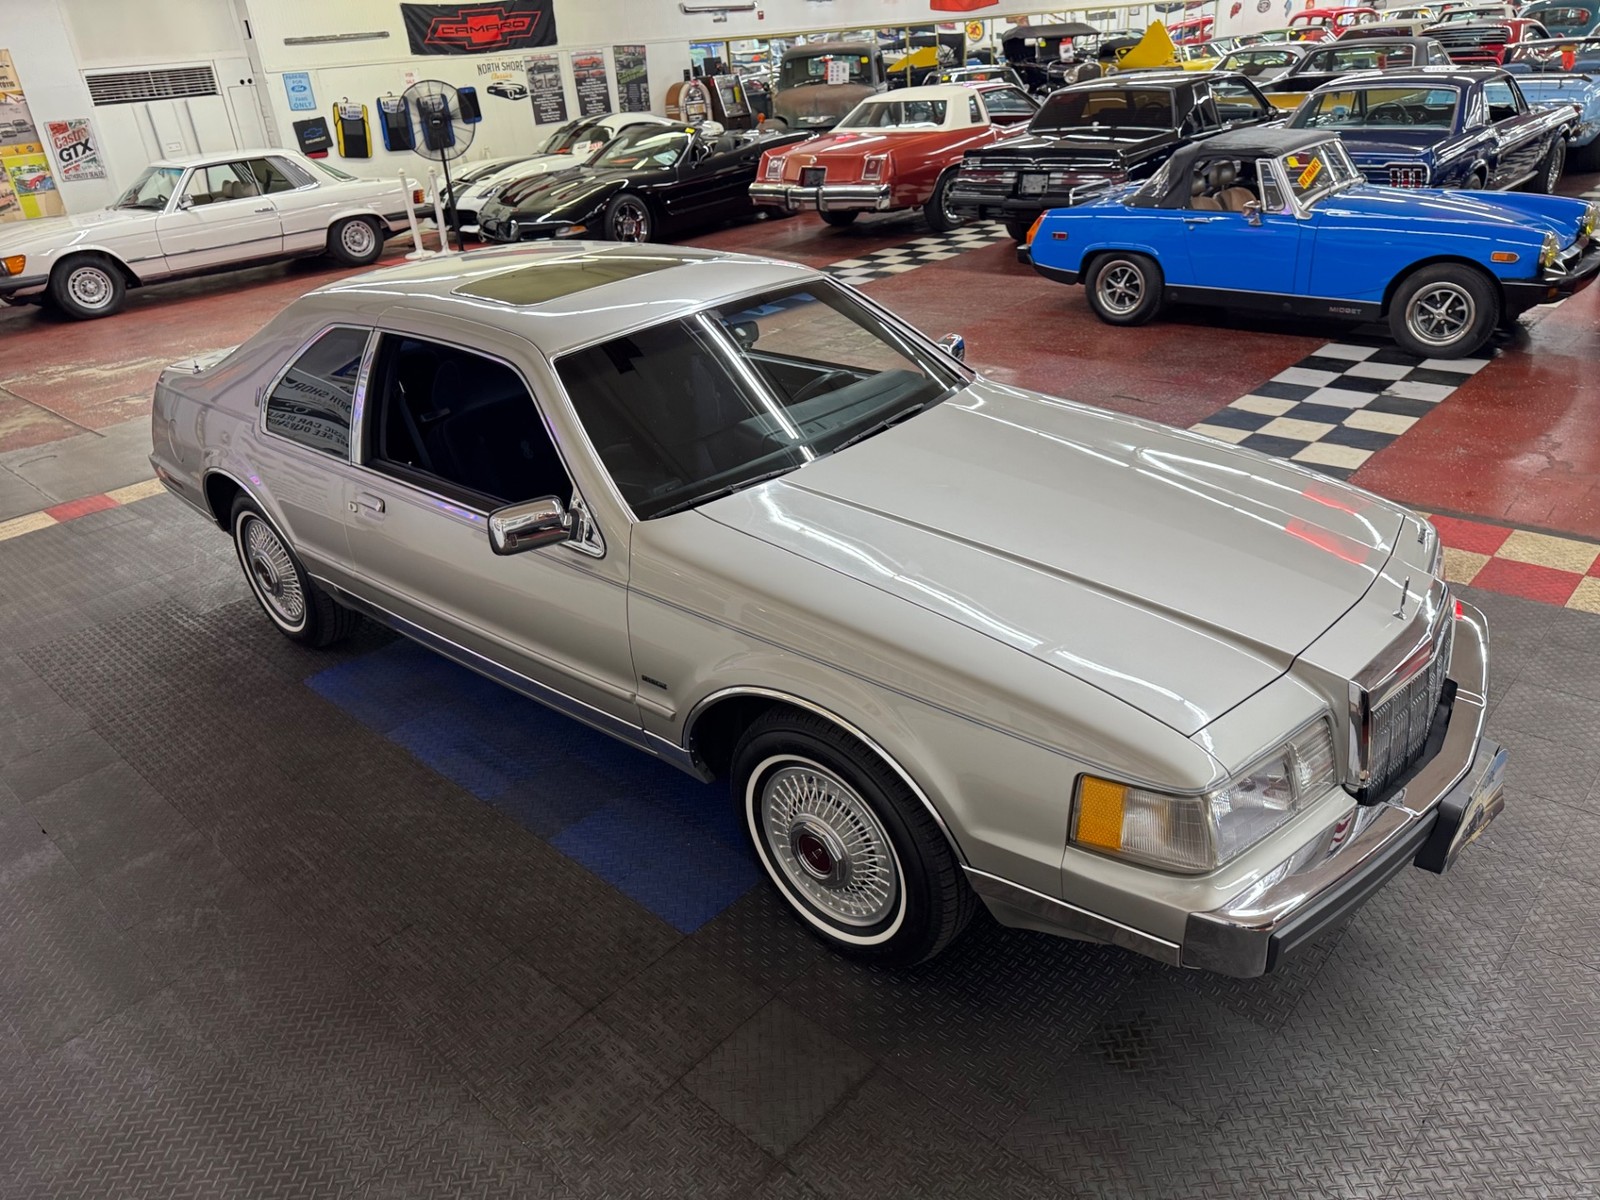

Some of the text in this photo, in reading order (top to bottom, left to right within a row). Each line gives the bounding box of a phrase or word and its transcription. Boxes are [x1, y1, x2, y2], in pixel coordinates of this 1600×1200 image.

[441, 20, 526, 34] CAMARO
[477, 60, 525, 76] NORTH SHORE
[59, 139, 93, 162] GTX
[1328, 306, 1362, 315] MIDGET
